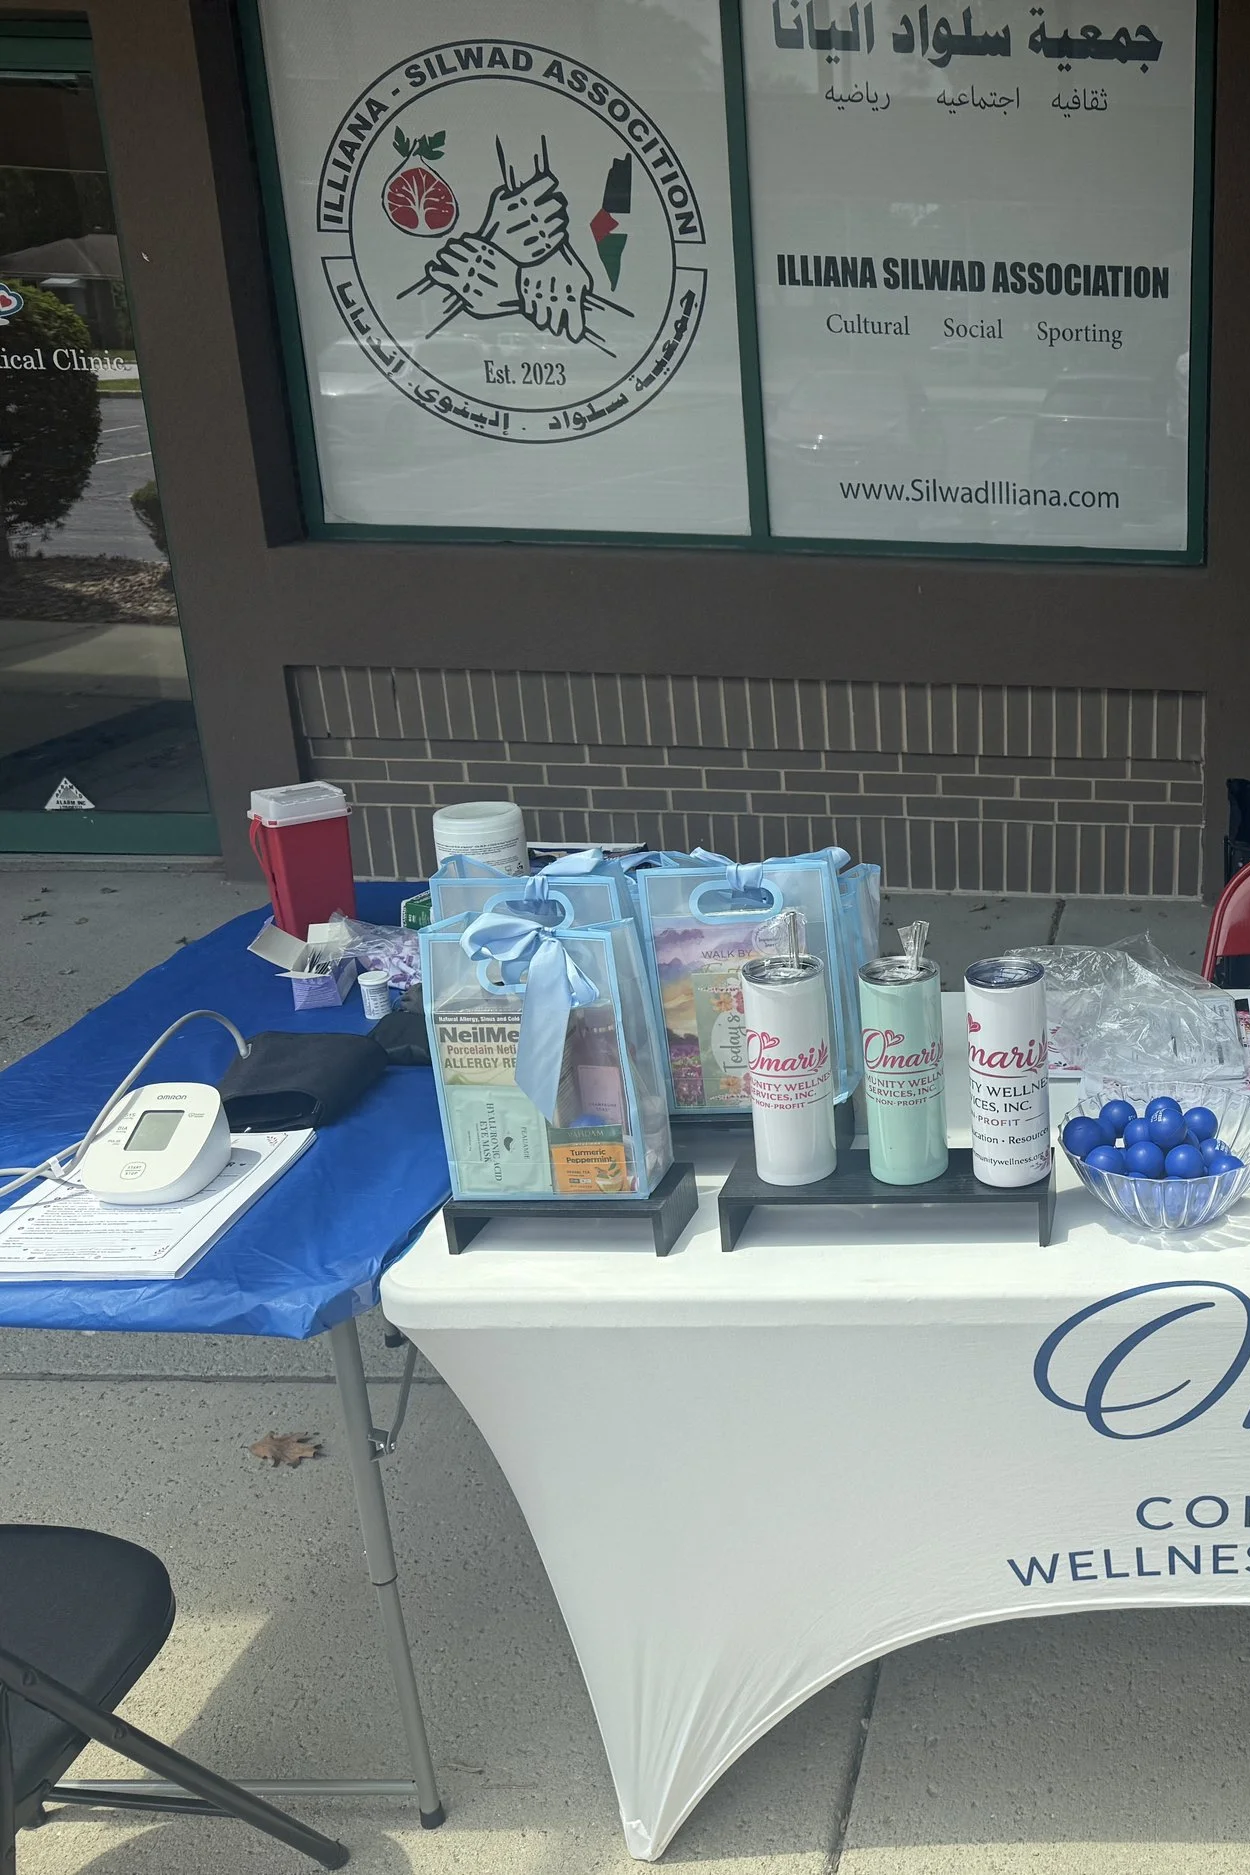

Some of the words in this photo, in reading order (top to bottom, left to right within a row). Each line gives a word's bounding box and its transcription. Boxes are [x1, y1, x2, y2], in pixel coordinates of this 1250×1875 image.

[892, 4, 1011, 68] سلواد
[1027, 6, 1163, 74] جمعية
[825, 80, 890, 112] رياضيه
[936, 85, 1020, 115] اجتماعيه
[1051, 87, 1108, 118] ثقافيه
[322, 97, 388, 226] ILLIANA
[404, 46, 533, 88] SILWAD
[543, 60, 698, 235] ASSOCITION
[777, 254, 877, 288] ILLIANA
[883, 257, 985, 292] SILWAD
[992, 262, 1169, 299] ASSOCIATION
[826, 313, 910, 337] Cultural
[943, 318, 1003, 339] Social
[1037, 321, 1123, 349] Sporting
[0, 347, 46, 370] ical
[53, 348, 125, 372] Clinic
[484, 360, 516, 385] Est.
[521, 361, 567, 386] 2023
[840, 479, 1120, 509] www.SilwadIlliana.com
[702, 950, 735, 959] WALK
[738, 949, 752, 958] BY
[439, 1027, 520, 1043] NeilMe
[447, 1045, 494, 1055] Porcelain
[497, 1044, 517, 1055] Neti
[746, 1029, 817, 1072] Omari
[863, 1028, 938, 1069] Omari
[968, 1039, 1038, 1069] mari
[444, 1058, 499, 1069] ALLERGY
[752, 1077, 781, 1092] UNITY
[908, 1067, 944, 1088] WELLN
[795, 1090, 817, 1100] INC.
[869, 1085, 916, 1098] SERVICES,
[876, 1097, 927, 1106] NON-PROFIT
[756, 1099, 805, 1110] NON-PROFIT
[972, 1096, 999, 1113] ICES,
[1004, 1101, 1032, 1112] INC.
[480, 1121, 489, 1138] EYE
[974, 1114, 1021, 1127] -PROFIT
[1008, 1127, 1049, 1144] Resource
[482, 1140, 491, 1162] MASK
[566, 1156, 612, 1164] Peppermint
[494, 1162, 502, 1181] ACID
